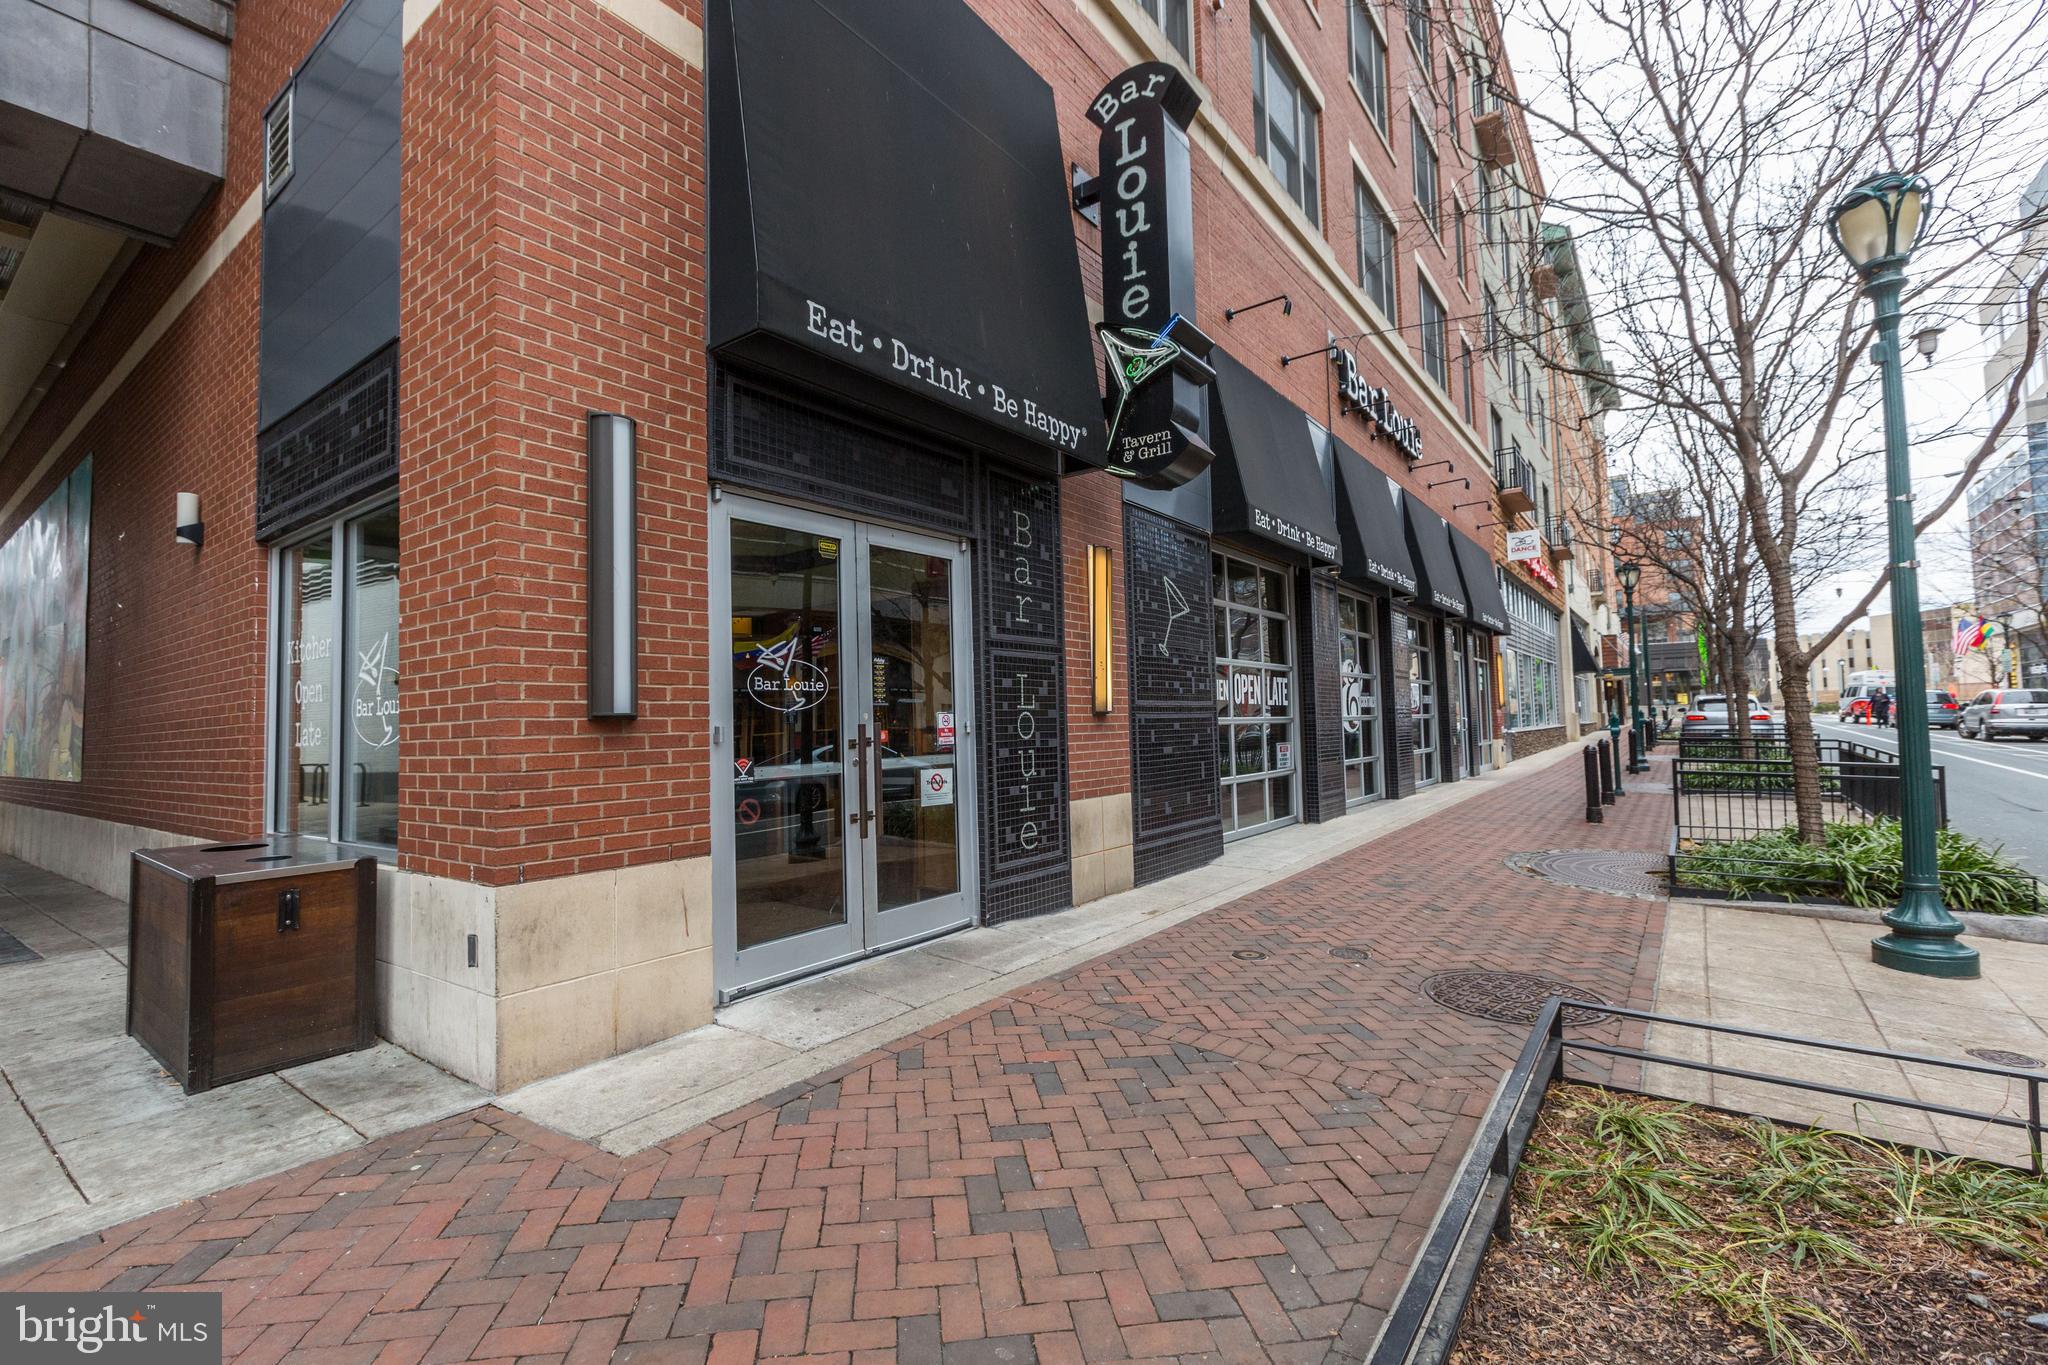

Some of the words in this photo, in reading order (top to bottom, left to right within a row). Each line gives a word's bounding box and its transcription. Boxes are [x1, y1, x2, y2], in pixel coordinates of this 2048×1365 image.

[1093, 73, 1166, 124] Bar
[1115, 117, 1151, 319] Louie
[806, 300, 864, 353] Eat
[891, 338, 972, 399] Drink
[992, 384, 1019, 418] Be
[1344, 349, 1379, 421] Bar
[1381, 386, 1423, 460] Louie
[1122, 430, 1172, 450] Tavern
[1123, 450, 1135, 463] &
[1138, 441, 1173, 460] Grill
[1255, 508, 1271, 530] Eat
[1276, 518, 1301, 543] Drink
[1306, 531, 1315, 549] Be
[1013, 510, 1033, 623] Bar
[1368, 558, 1378, 574] Eat
[295, 680, 323, 709] Open
[754, 676, 780, 691] Bar
[783, 677, 824, 691] Louie
[1233, 673, 1261, 705] OPEN
[1266, 676, 1289, 706] LATE
[356, 698, 374, 717] Bar
[376, 697, 400, 716] Loui
[295, 722, 321, 747] Late
[1017, 674, 1038, 849] Louie
